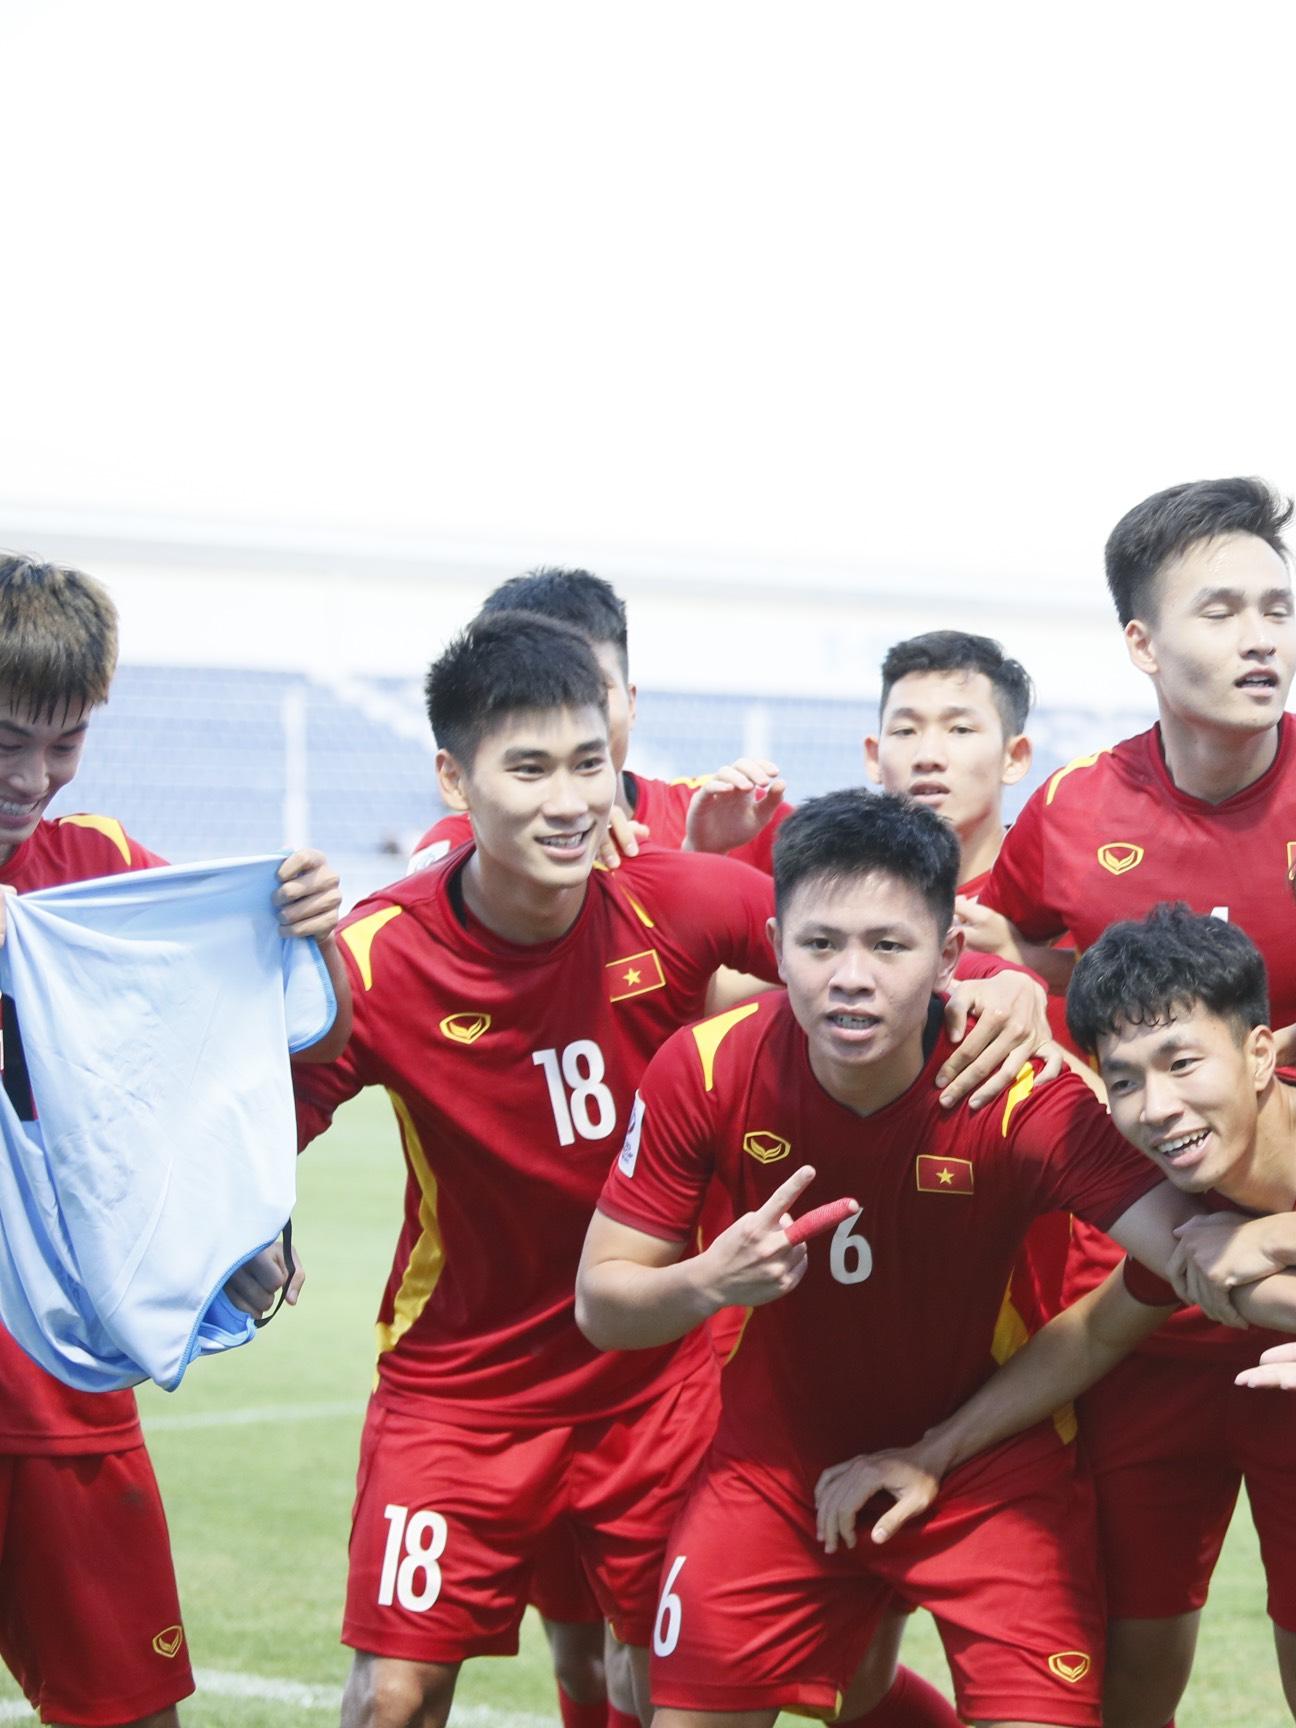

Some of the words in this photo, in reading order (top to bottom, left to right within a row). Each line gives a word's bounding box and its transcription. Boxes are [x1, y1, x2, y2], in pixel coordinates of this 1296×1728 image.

[532, 1039, 617, 1147] 18
[830, 1207, 873, 1285] 6
[377, 1503, 448, 1613] 18
[653, 1554, 688, 1658] 6
